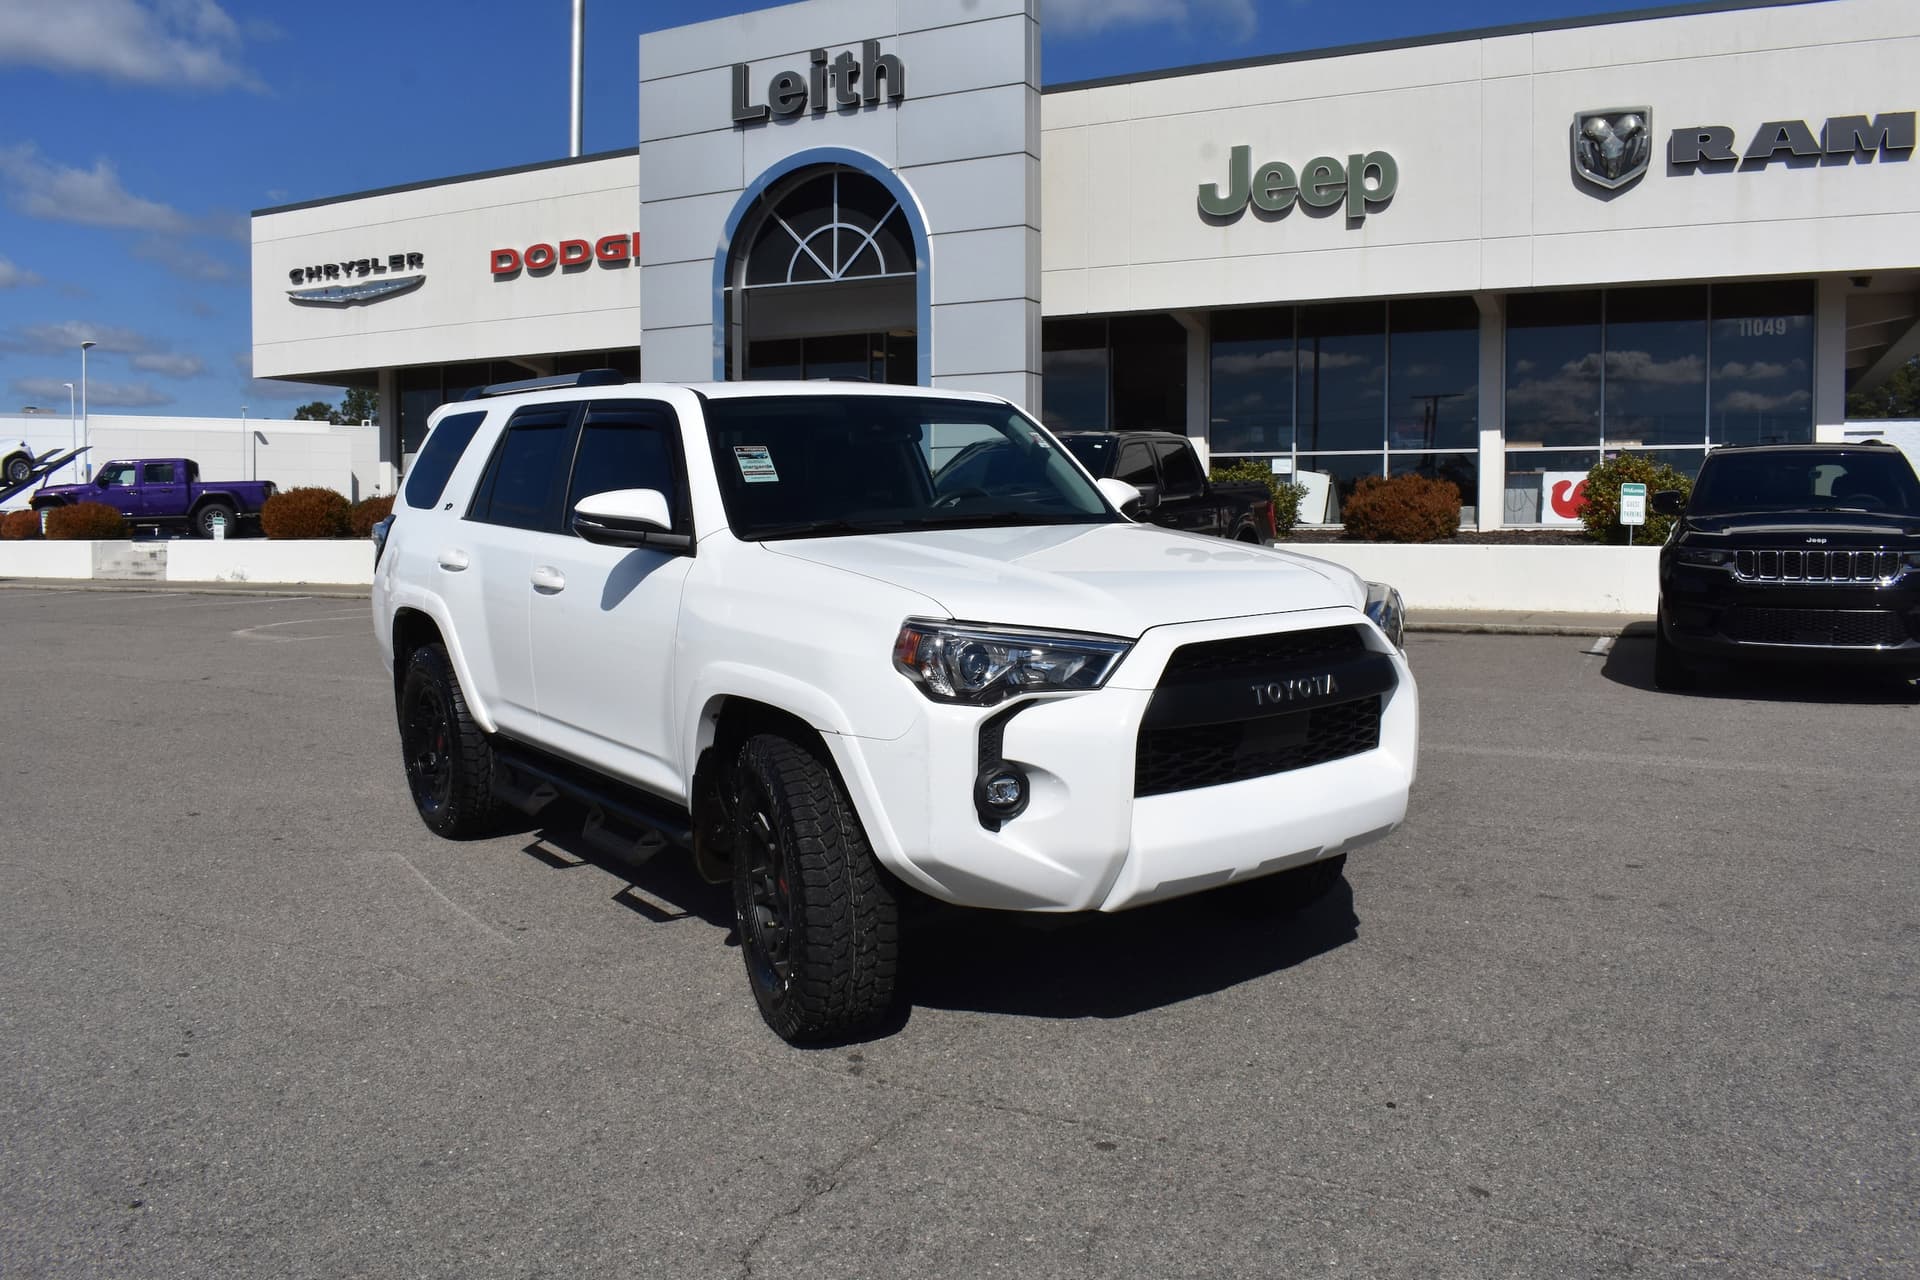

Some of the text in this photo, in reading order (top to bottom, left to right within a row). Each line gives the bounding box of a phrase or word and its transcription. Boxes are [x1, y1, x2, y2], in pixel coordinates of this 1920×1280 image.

[732, 39, 905, 124] Leith
[1668, 112, 1916, 174] RAM
[1198, 144, 1399, 228] Jeep
[289, 252, 424, 285] CHRYSLER
[1738, 318, 1787, 336] 11049
[1252, 674, 1338, 705] TOYOTA
